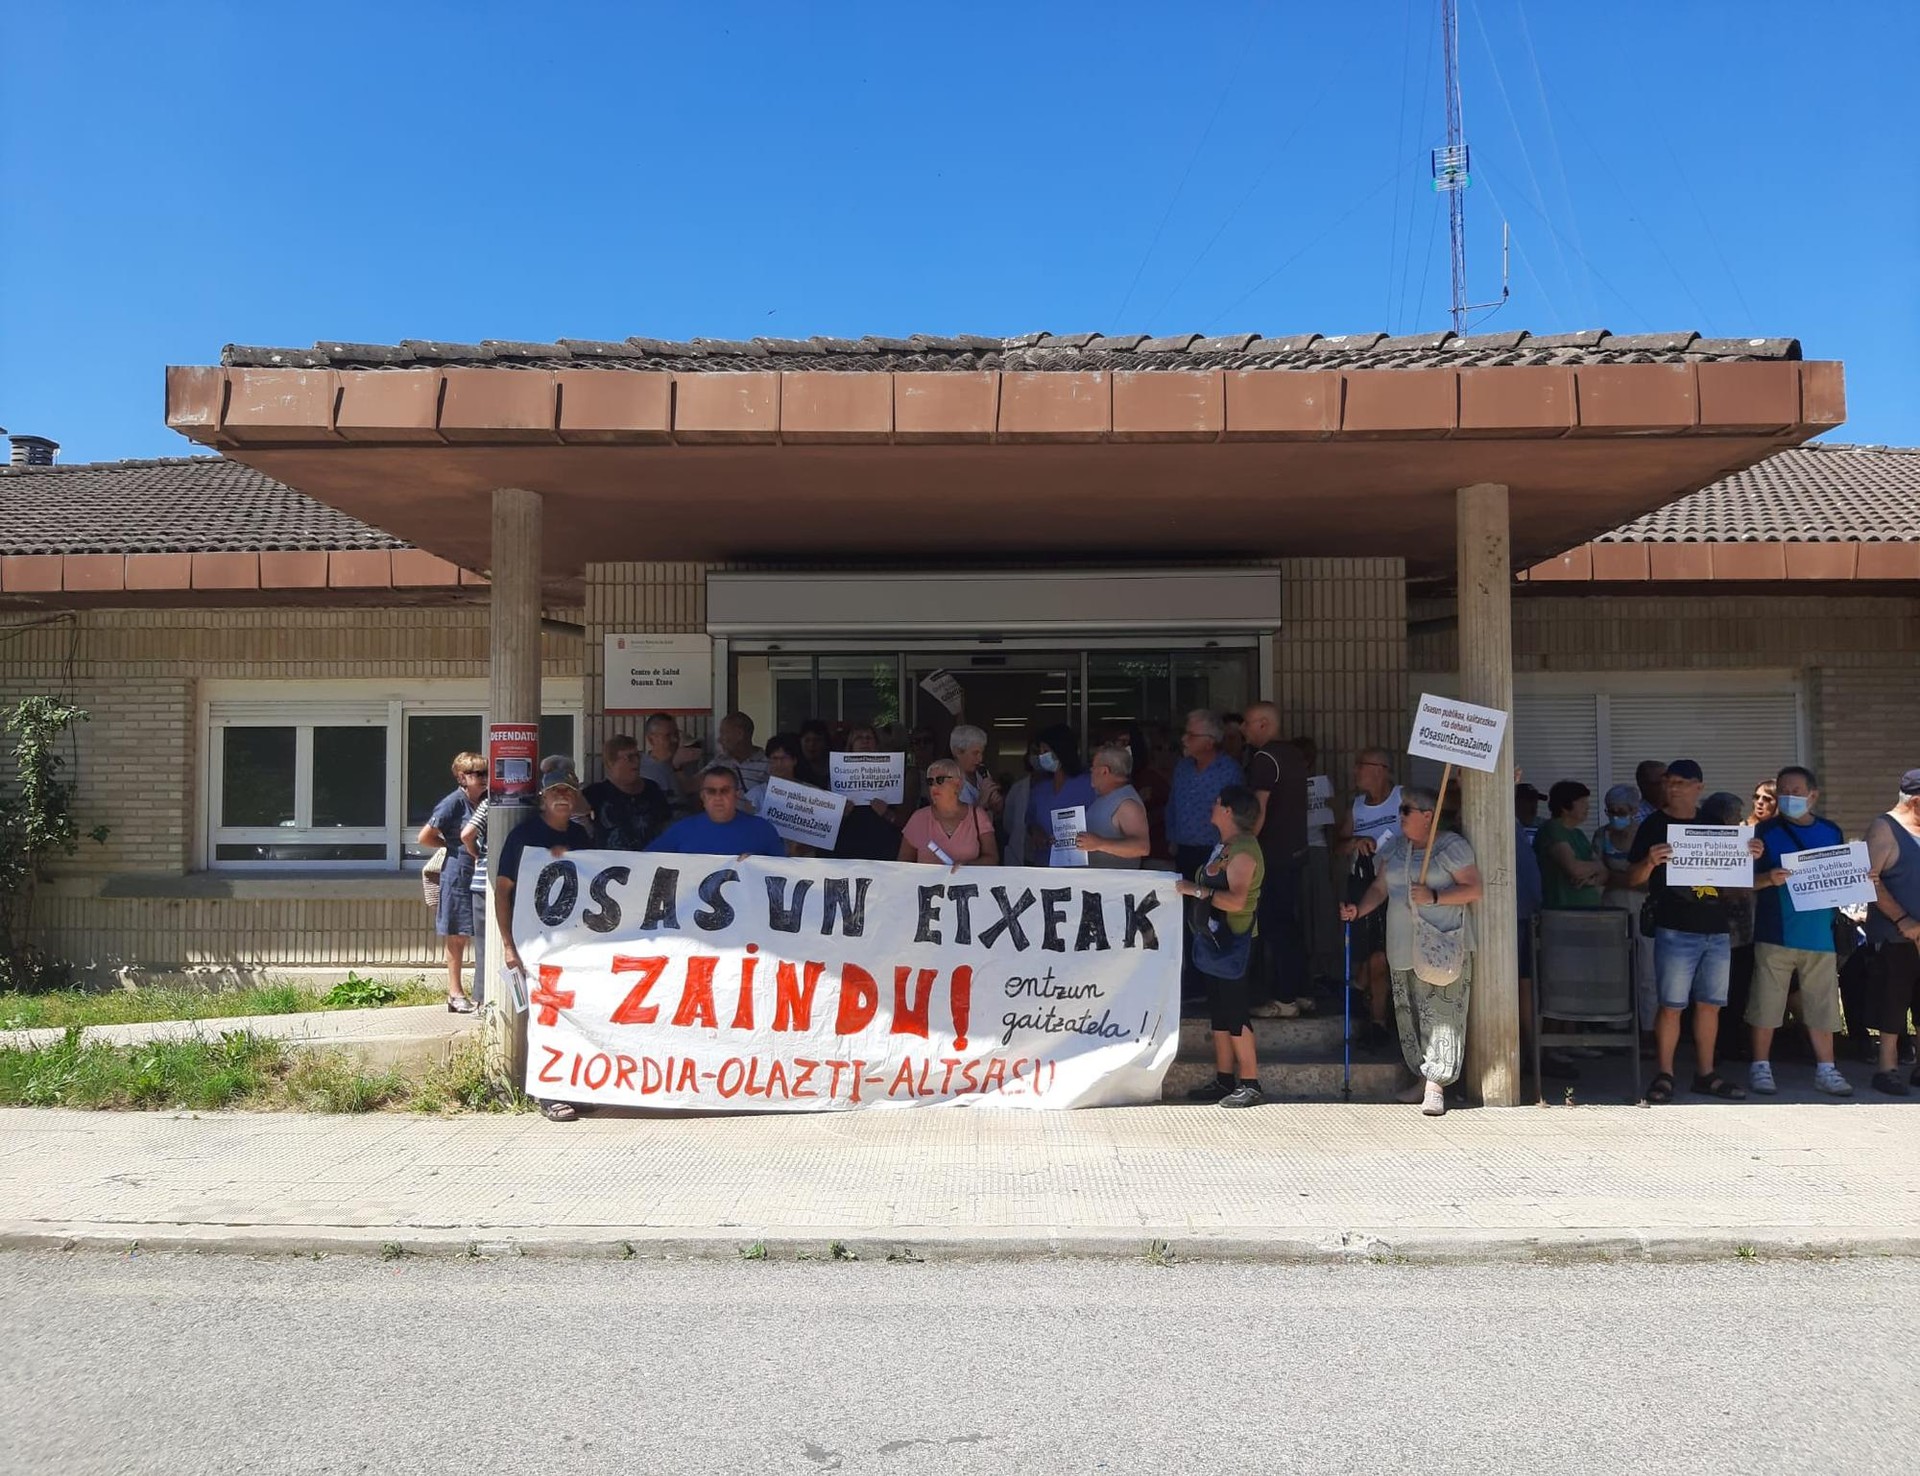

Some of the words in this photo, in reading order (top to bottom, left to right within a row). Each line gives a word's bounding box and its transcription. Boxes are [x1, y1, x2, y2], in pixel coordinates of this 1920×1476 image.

[631, 668, 651, 676] Centro
[652, 668, 660, 676] de
[662, 668, 680, 676] Salud
[1422, 703, 1442, 715] Osasun
[1441, 720, 1450, 728] eta
[1419, 726, 1493, 753] #OsasunEtxeaZaindu
[834, 766, 859, 774] Osasun
[861, 766, 890, 774] Publikoa
[834, 780, 899, 789] GUZTIENTZAT!
[767, 807, 832, 833] #OsasunEtxeaZaindu
[1673, 841, 1702, 849] Osasun
[1704, 841, 1737, 850] Publikoa
[1672, 857, 1747, 867] GUZTIENTZAT!
[1819, 861, 1853, 871] Publikoa
[1808, 872, 1820, 881] eta
[1822, 867, 1868, 879] kalitatezkoa
[1792, 873, 1866, 892] GUZTIENTZAT!
[534, 860, 873, 938] OSASUN
[913, 884, 1161, 952] ETXEAK
[1004, 966, 1105, 1000] entzun
